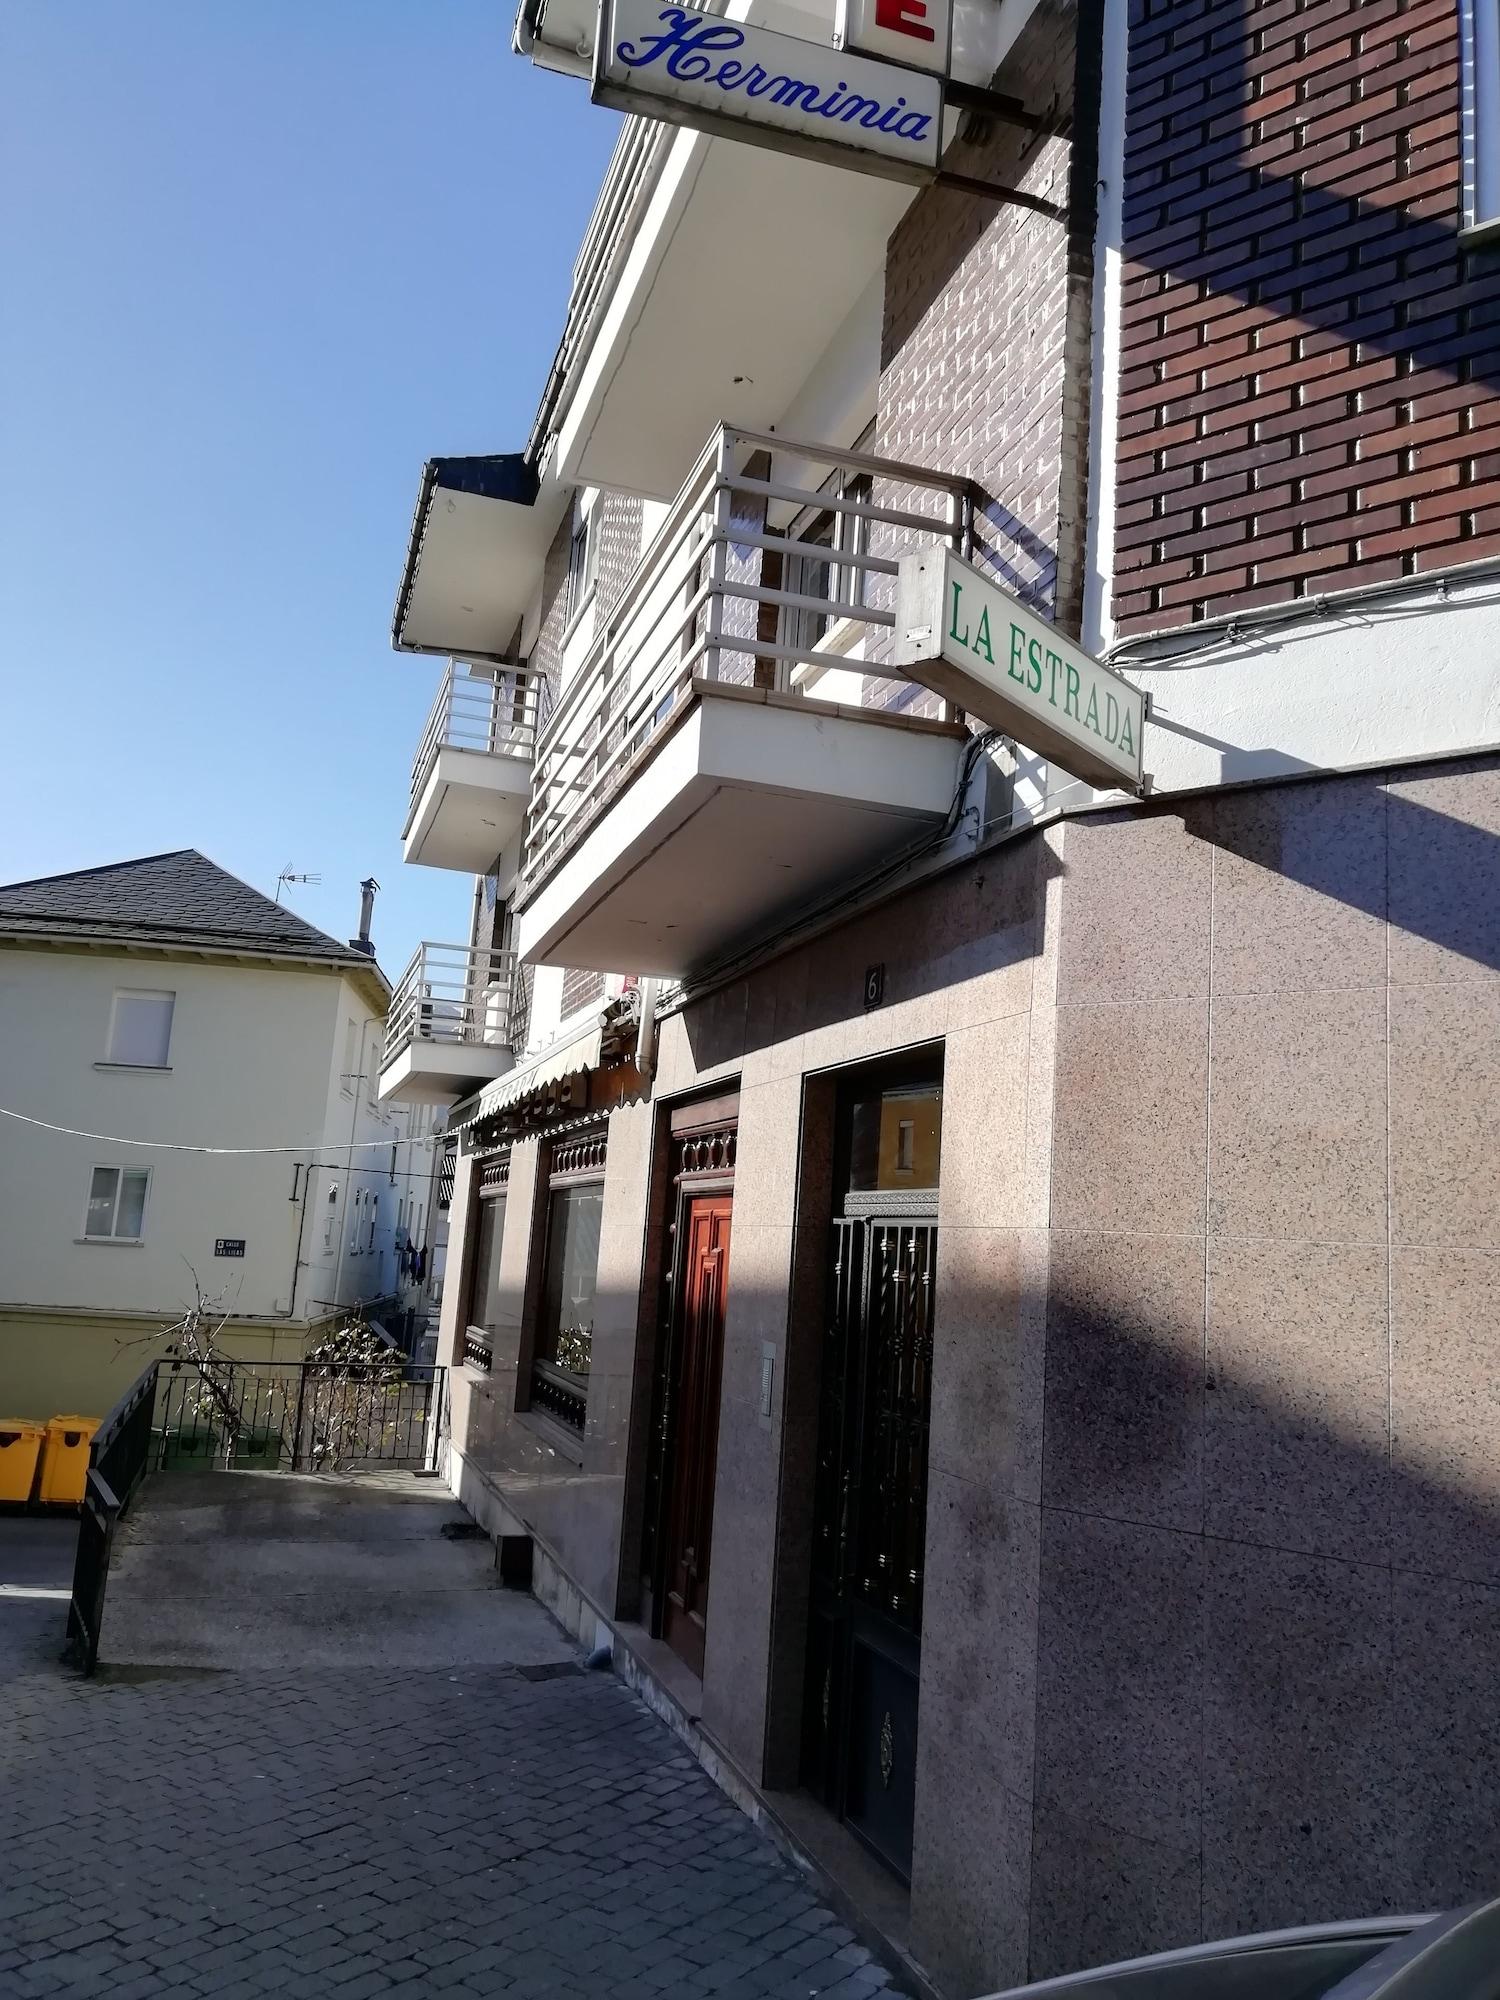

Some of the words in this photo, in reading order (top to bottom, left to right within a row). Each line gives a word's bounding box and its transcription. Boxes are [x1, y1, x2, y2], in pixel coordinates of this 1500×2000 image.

[616, 8, 933, 142] Herminia
[949, 580, 995, 666] LA
[1007, 621, 1136, 759] ESTRADA
[868, 972, 877, 1000] 6
